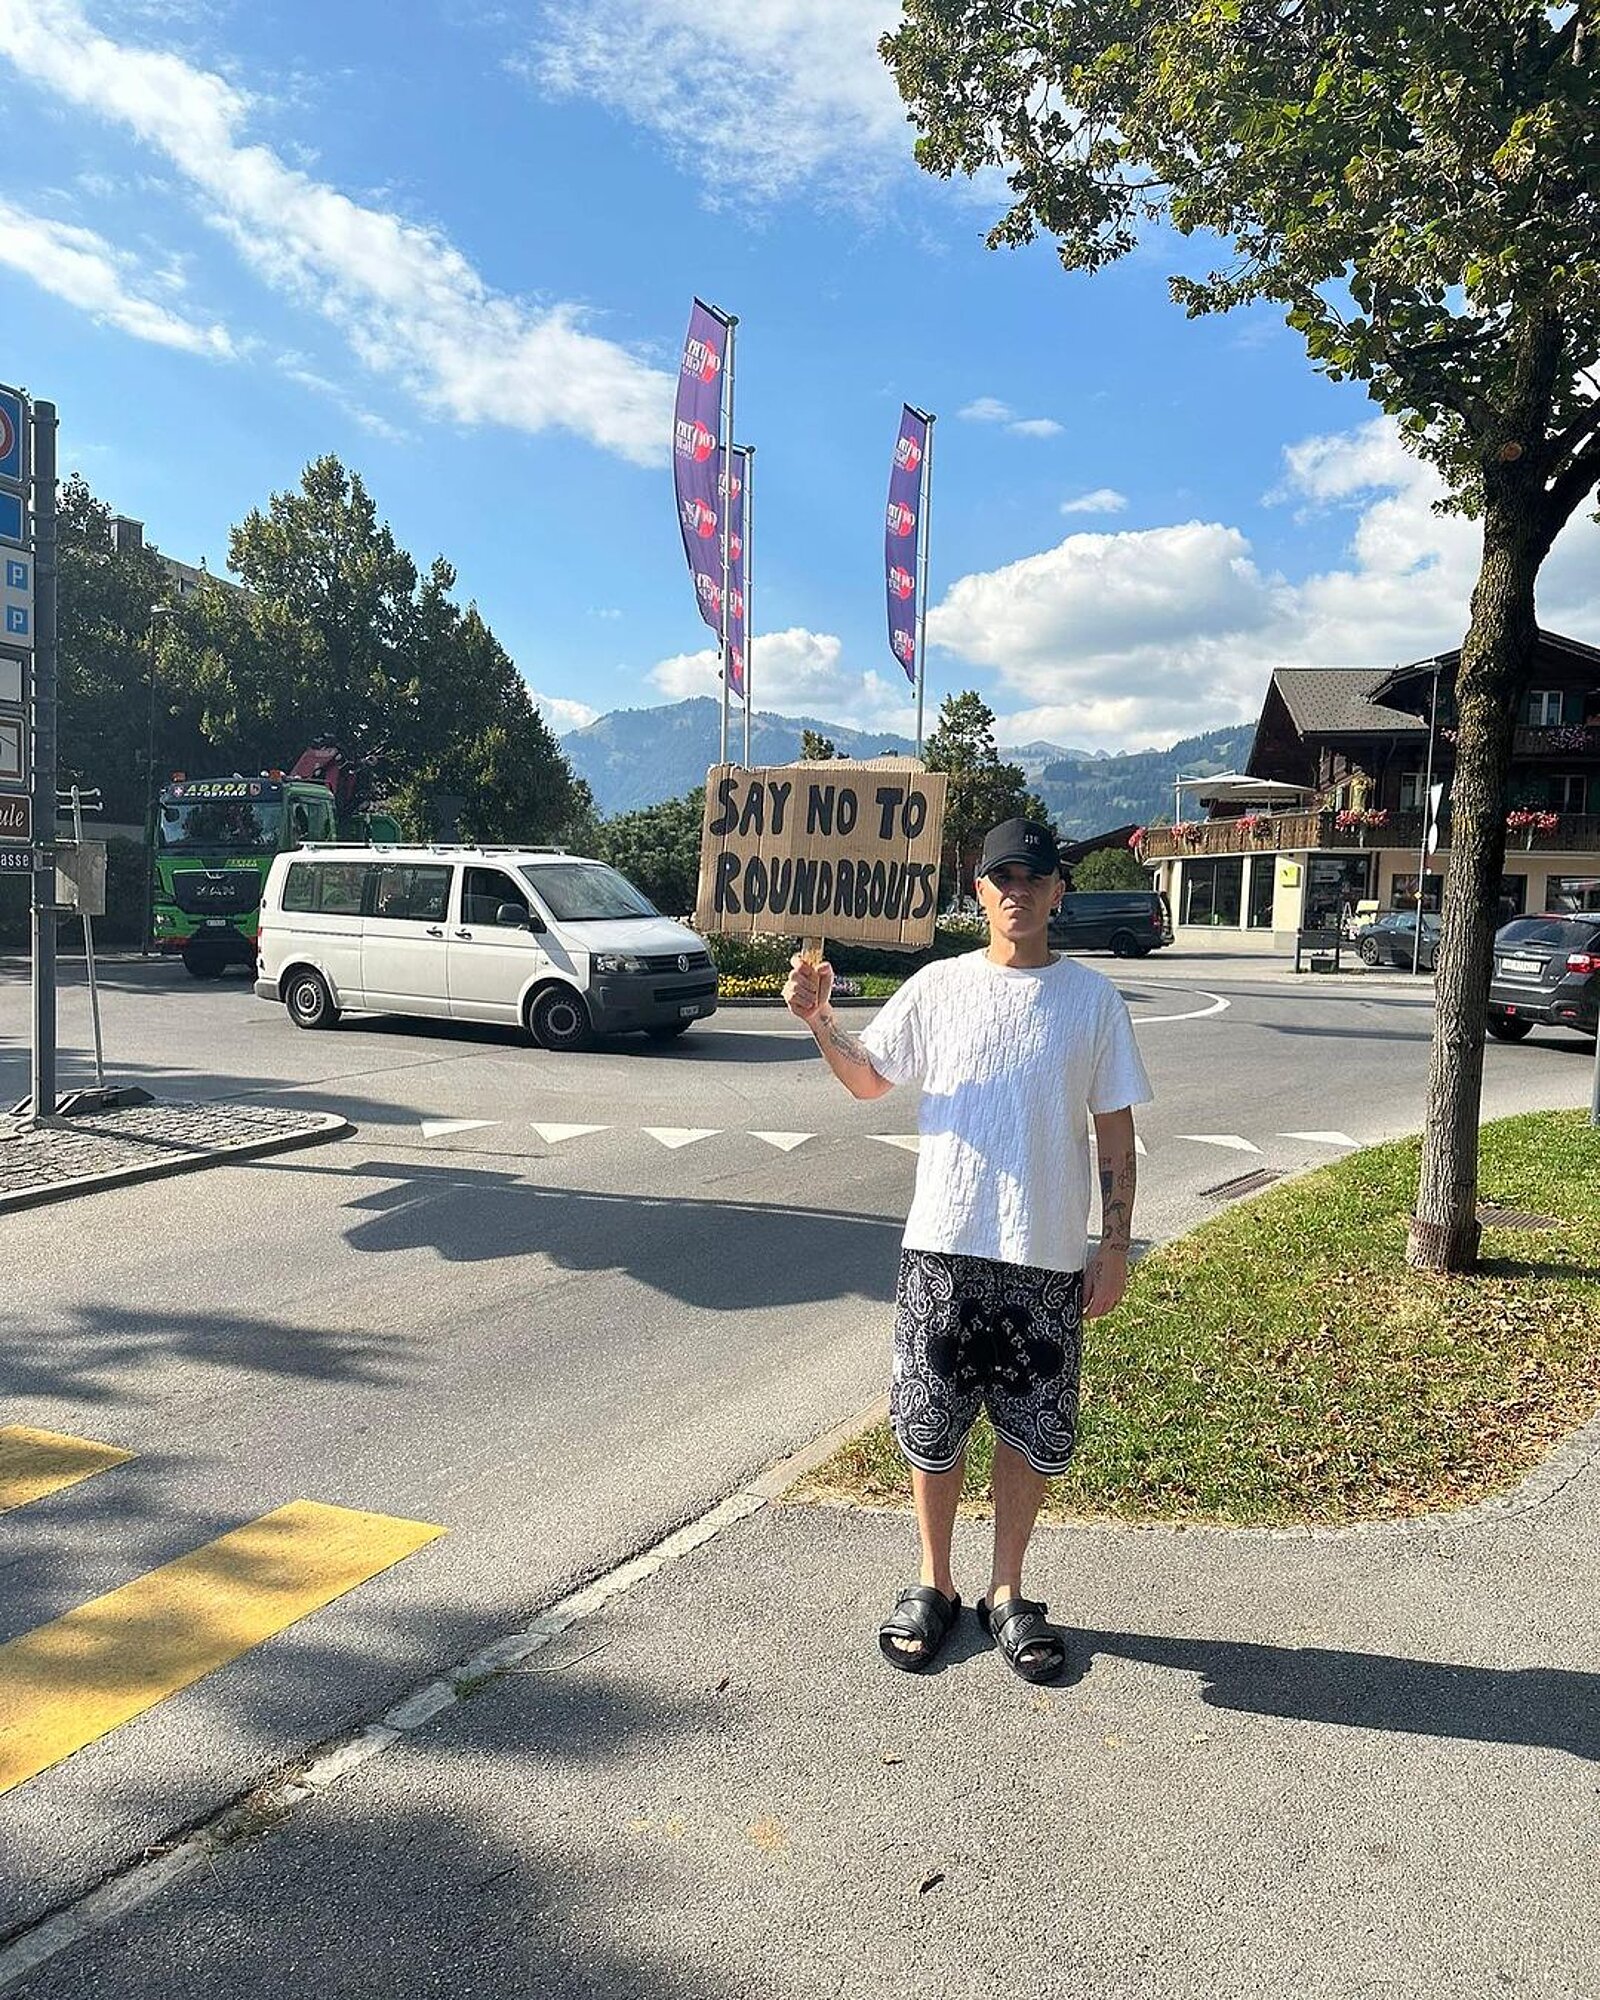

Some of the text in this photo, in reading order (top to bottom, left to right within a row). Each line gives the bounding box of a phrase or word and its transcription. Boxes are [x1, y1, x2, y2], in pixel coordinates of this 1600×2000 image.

[12, 565, 23, 585] P
[12, 611, 23, 630] P
[710, 778, 927, 840] SAY NO TO
[714, 851, 935, 920] ROUNDABOUTS
